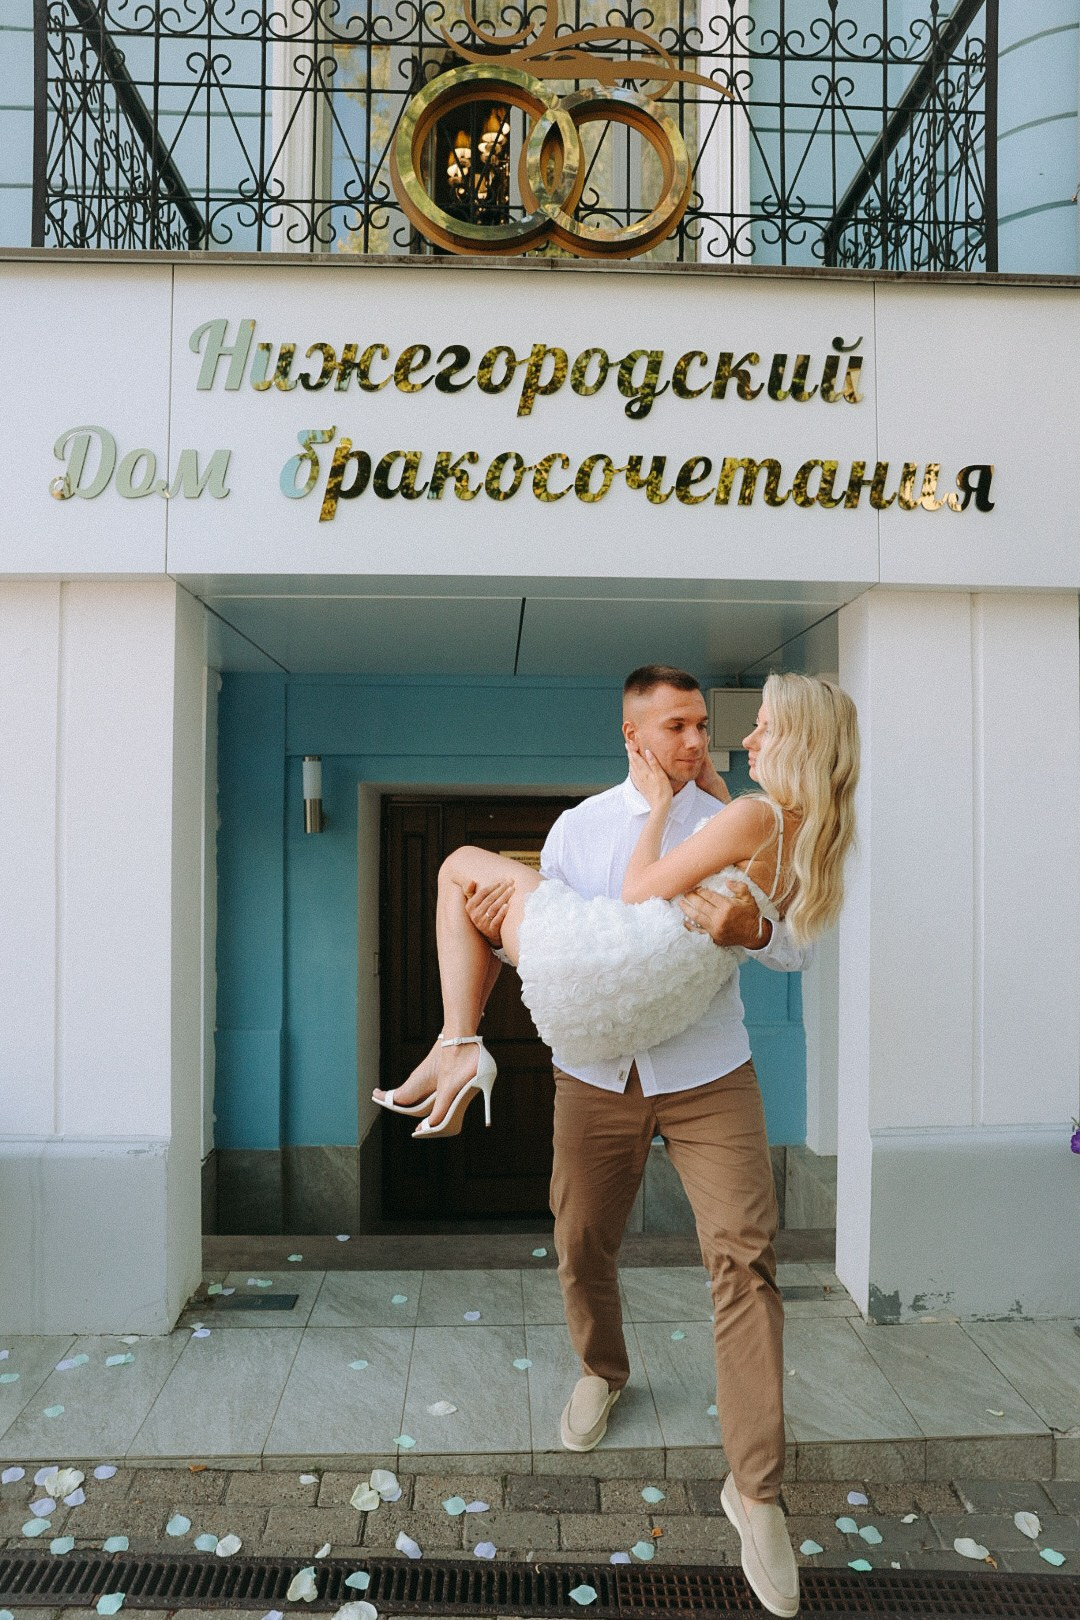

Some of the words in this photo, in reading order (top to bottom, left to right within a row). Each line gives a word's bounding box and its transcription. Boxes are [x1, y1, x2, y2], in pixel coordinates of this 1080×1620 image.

[189, 318, 864, 419] Нижегородский
[49, 424, 232, 500] Дом
[279, 425, 996, 523] бракосочетания
